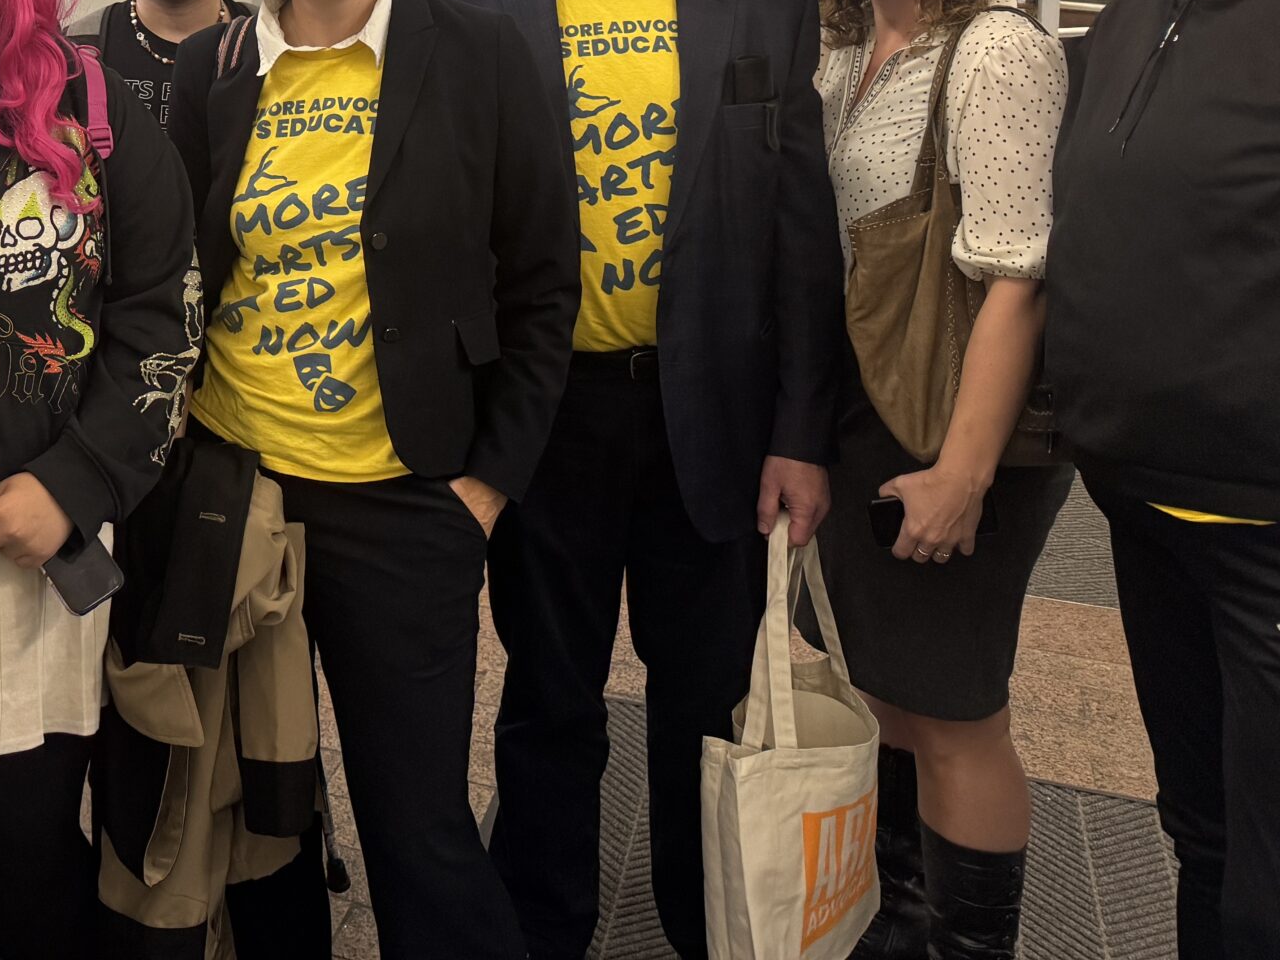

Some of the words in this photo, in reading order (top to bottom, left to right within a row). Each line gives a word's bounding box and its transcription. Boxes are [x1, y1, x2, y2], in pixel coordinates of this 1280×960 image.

[235, 175, 369, 248] MORE
[252, 224, 361, 281] ARTS
[274, 277, 336, 313] ED
[252, 311, 372, 356] NOW
